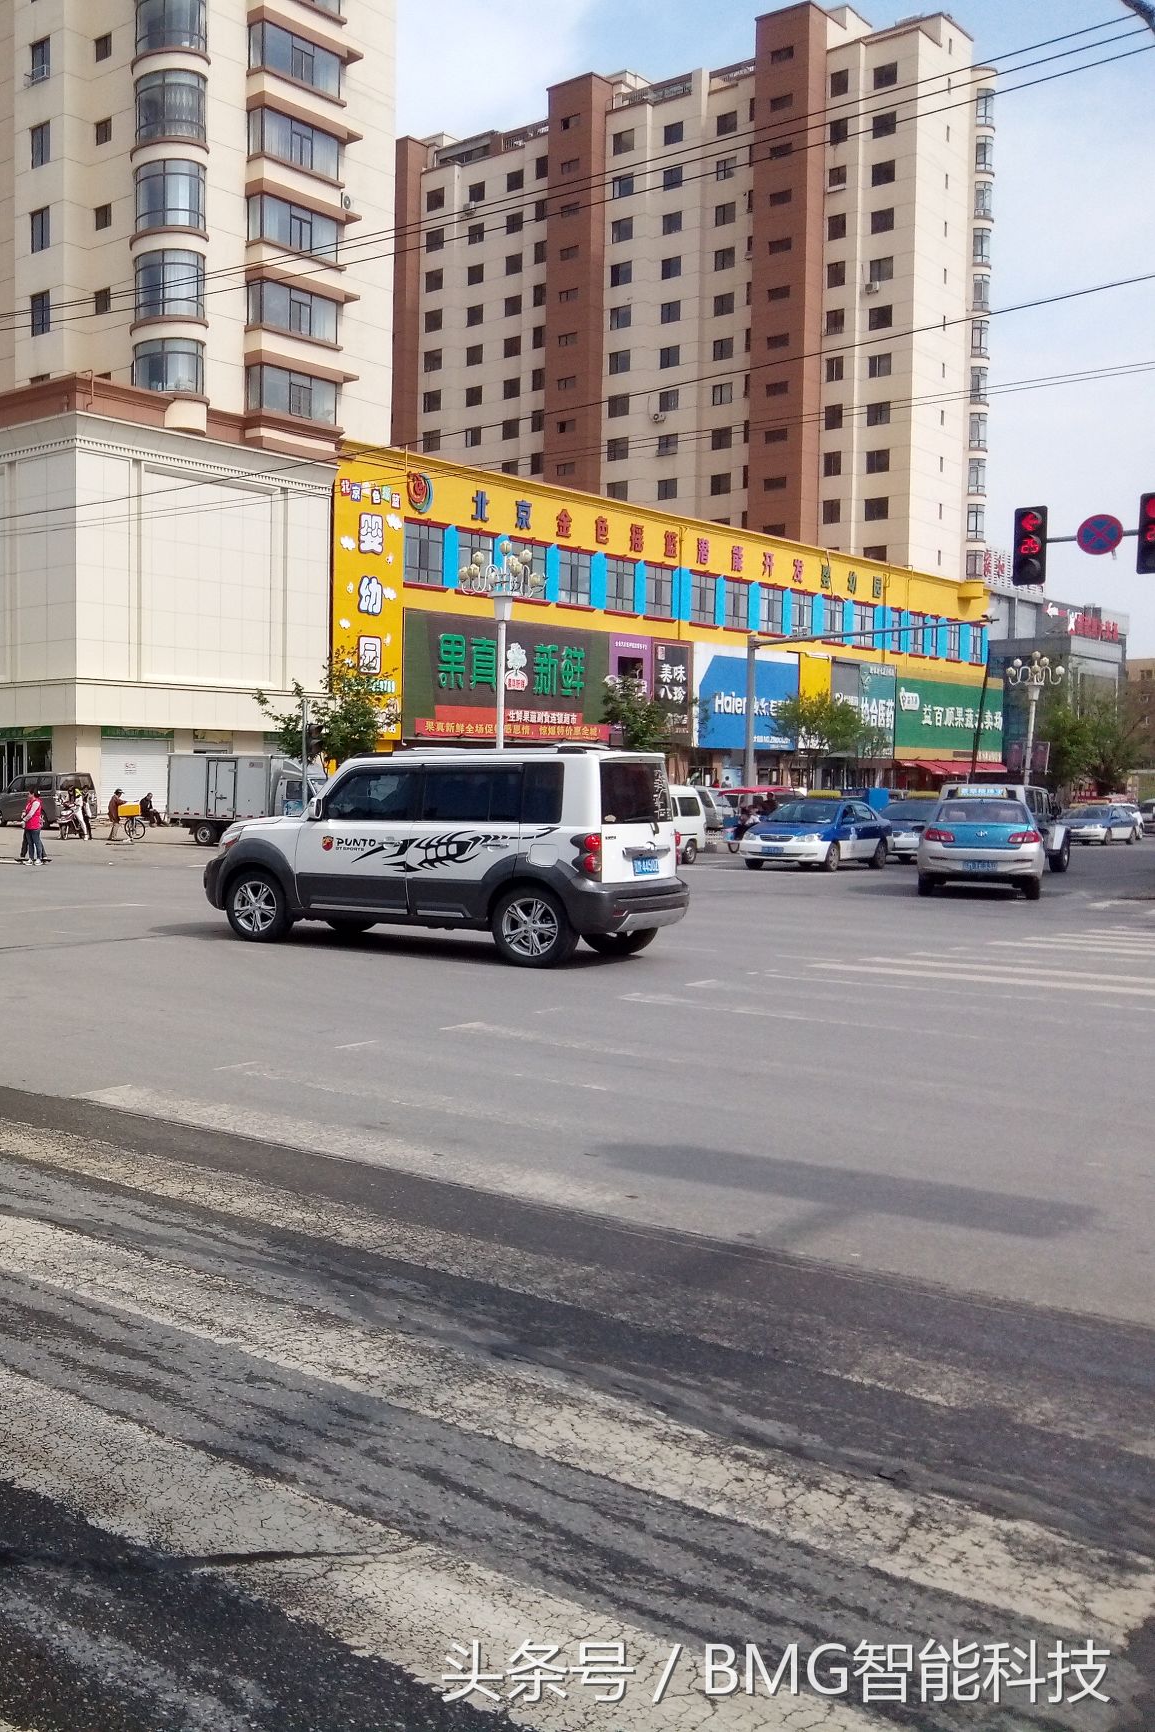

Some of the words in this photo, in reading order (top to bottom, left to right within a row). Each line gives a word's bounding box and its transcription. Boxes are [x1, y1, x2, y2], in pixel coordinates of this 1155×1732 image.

[437, 633, 498, 692] 果真
[533, 643, 586, 698] 新鲜
[659, 663, 687, 683] 美味
[659, 684, 687, 705] 八珍
[714, 691, 747, 715] Haier
